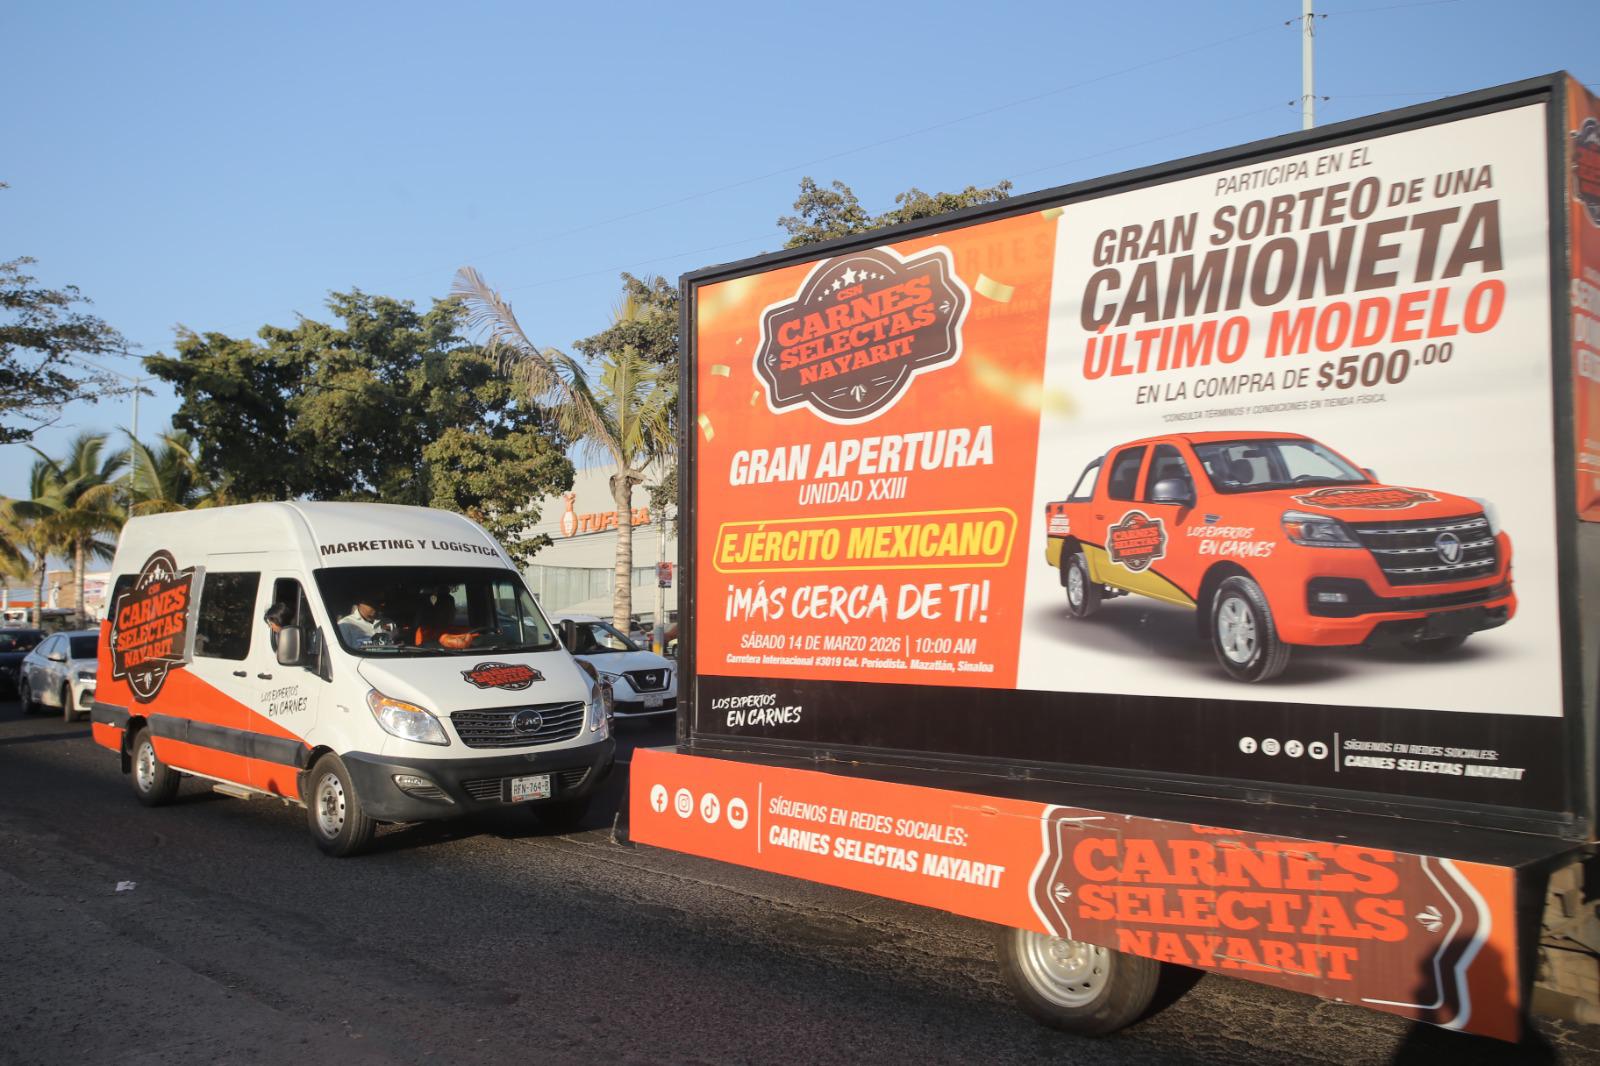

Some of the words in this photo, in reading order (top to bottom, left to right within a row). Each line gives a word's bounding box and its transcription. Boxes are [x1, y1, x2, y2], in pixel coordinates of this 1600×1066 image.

[1215, 154, 1310, 197] PARTICIPA
[1315, 150, 1342, 176] EN
[1348, 146, 1373, 170] EL
[1092, 212, 1199, 268] GRAN
[1209, 175, 1381, 247] SORTEO
[1387, 177, 1425, 208] DE
[1434, 164, 1494, 200] UNA
[1080, 199, 1505, 333] CAMIONETA
[776, 273, 933, 348] CARNES
[1081, 314, 1251, 381] ÚLTIMO
[1264, 278, 1507, 360] MODELO
[779, 303, 937, 372] SELECTAS
[799, 334, 914, 386] NAYARIT
[1136, 385, 1160, 405] EN
[1164, 380, 1188, 402] LA
[1192, 372, 1276, 399] COMPRA
[1283, 368, 1308, 389] DE
[1246, 407, 1251, 416] Y
[1252, 401, 1308, 415] CONDICIONES
[1310, 400, 1322, 409] EN
[1324, 396, 1355, 408] TIENDA
[728, 443, 811, 486] GRAN
[815, 425, 994, 479] APERTURA
[799, 481, 863, 505] UNIDAD
[867, 477, 908, 500] XXIII
[320, 539, 414, 556] MARKETING
[417, 540, 426, 549] Y
[720, 520, 841, 563] EJÉRCITO
[847, 520, 1006, 560] MEXICANO
[1199, 539, 1218, 555] EN
[1219, 541, 1276, 558] CARNES
[119, 584, 188, 630] CARNES
[725, 580, 788, 622] ¡MÁS
[791, 583, 888, 624] CERCA
[897, 582, 942, 622] DE
[949, 579, 990, 623] TI!
[117, 612, 184, 652] SELECTAS
[124, 638, 173, 668] NAYARIT
[741, 630, 785, 650] SÁBADO
[789, 634, 802, 650] 14
[805, 635, 821, 650] DE
[823, 635, 867, 651] MARZO
[869, 636, 901, 652] 2026
[914, 637, 952, 654] 10:00
[953, 638, 977, 655] AM
[726, 653, 761, 664] Carretera
[762, 654, 813, 666] Internacional
[815, 656, 842, 667] #3019
[843, 656, 859, 668] Col.
[910, 659, 956, 673] Mazatlán,
[957, 661, 994, 672] Sinaloa
[269, 703, 279, 717] EN
[280, 697, 307, 715] CARNES
[712, 697, 730, 709] LOS
[730, 693, 776, 708] EXPERTOS
[727, 711, 745, 727] EN
[747, 705, 802, 727] CARNES
[1344, 755, 1396, 770] CARNES
[1397, 759, 1463, 776] SELECTAS
[1464, 765, 1525, 780] NAYARIT
[1393, 744, 1408, 753] EN
[1409, 745, 1443, 756] REDES
[769, 795, 827, 824] SÍGUENOS
[829, 809, 847, 826] EN
[849, 811, 894, 835] REDES
[895, 818, 968, 847] SOCIALES:
[769, 827, 830, 856] CARNES
[833, 838, 917, 873] SELECTAS
[922, 856, 1005, 889] NAYARIT
[1073, 837, 1400, 895] CARNES
[1077, 884, 1408, 942] SELECTAS
[1117, 928, 1359, 981] NAYARIT
